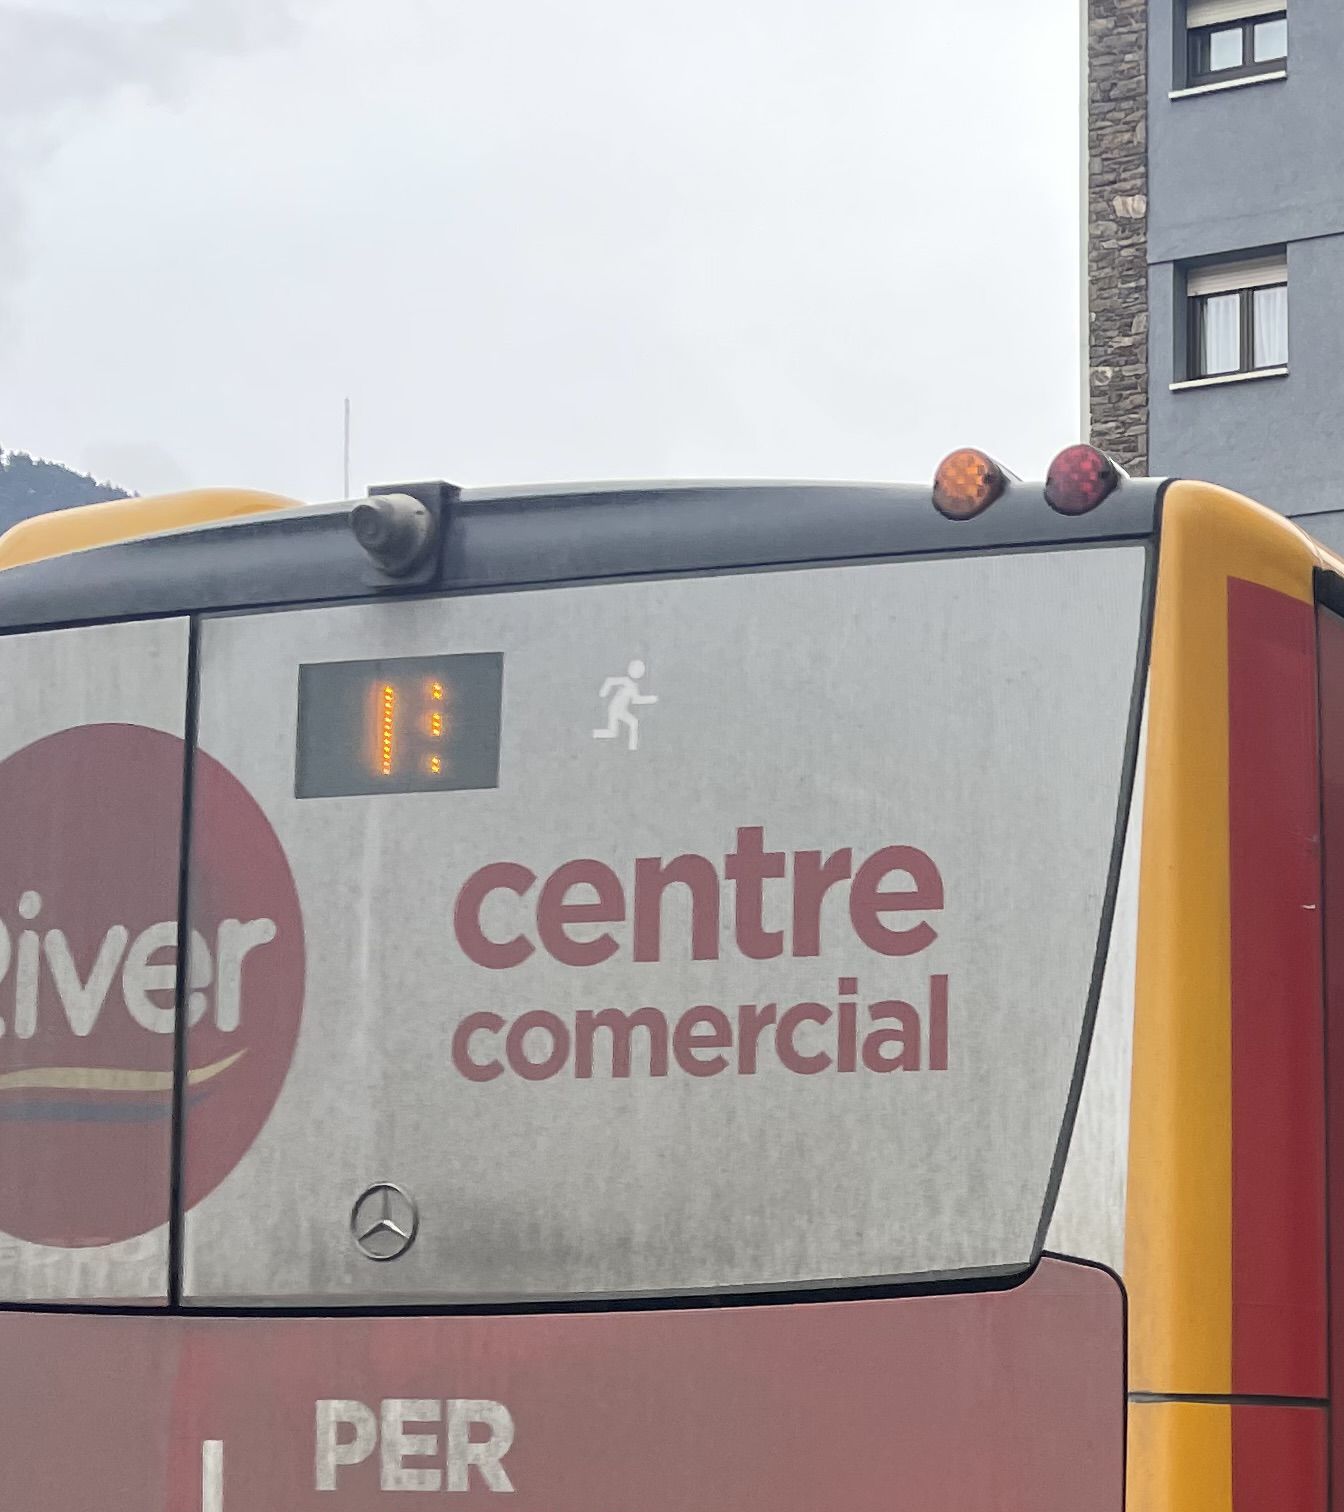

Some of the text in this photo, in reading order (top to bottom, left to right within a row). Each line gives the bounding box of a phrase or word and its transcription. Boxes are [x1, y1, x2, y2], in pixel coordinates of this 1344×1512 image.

[453, 825, 945, 970] centre
[0, 890, 277, 1039] iver
[450, 974, 950, 1083] comercial
[314, 1398, 516, 1493] PER
